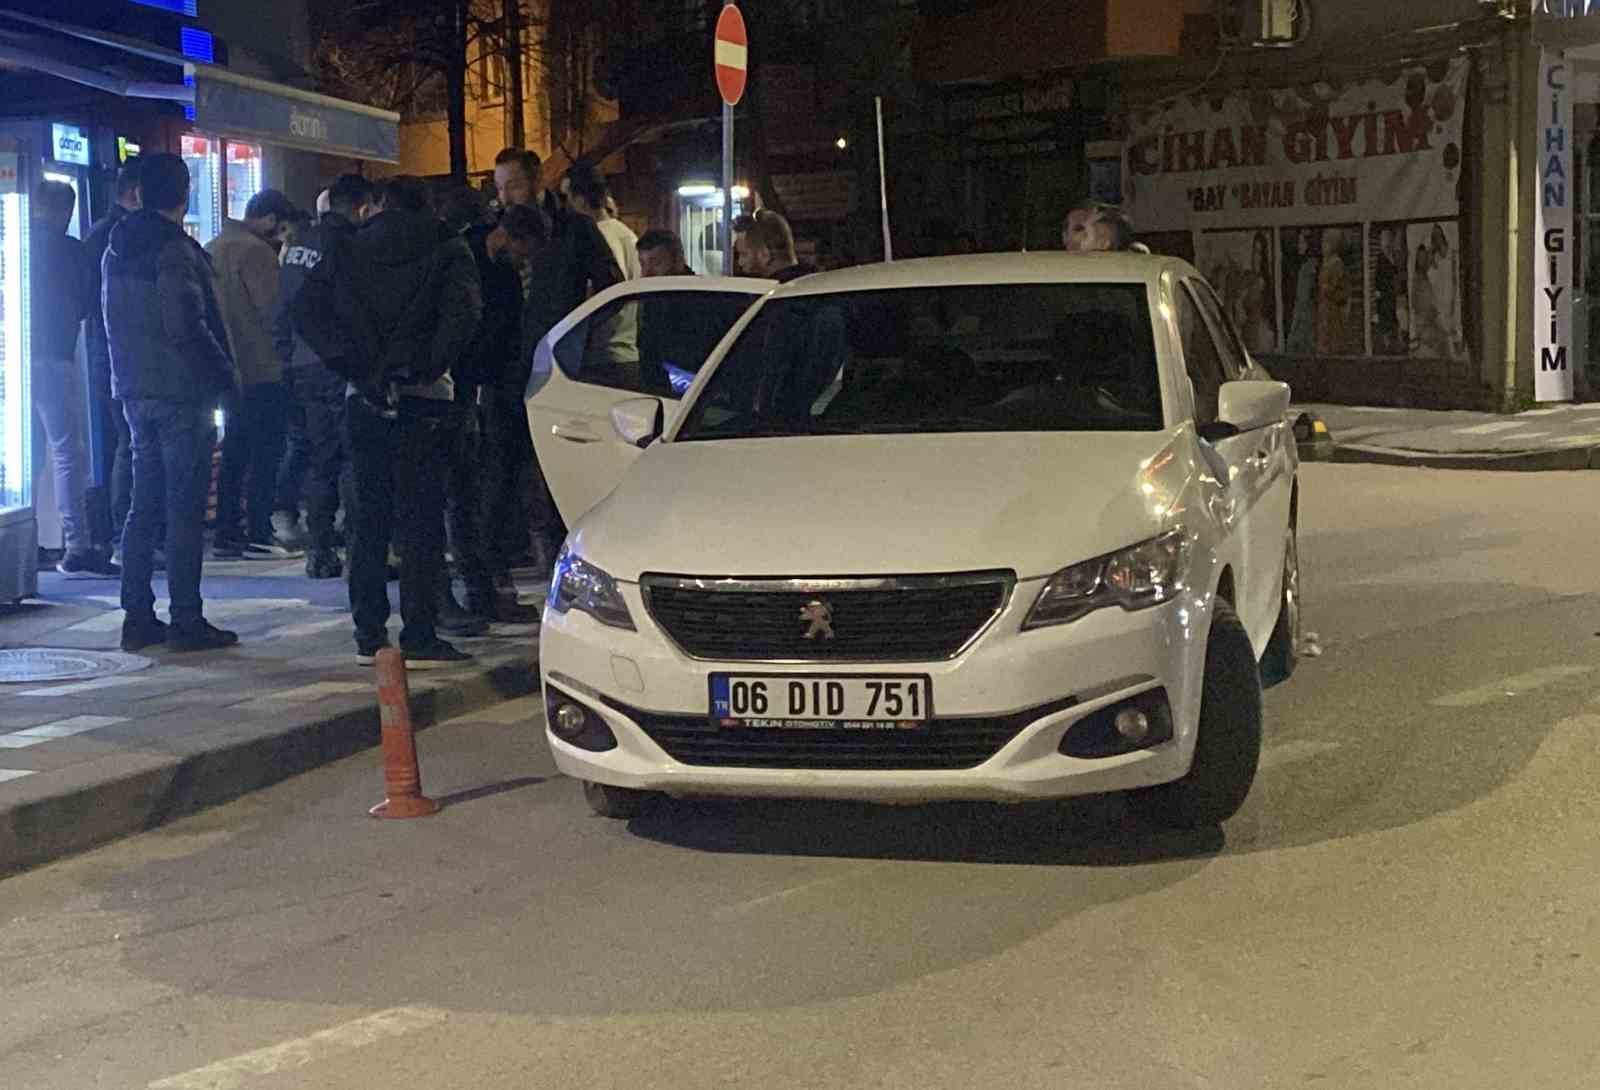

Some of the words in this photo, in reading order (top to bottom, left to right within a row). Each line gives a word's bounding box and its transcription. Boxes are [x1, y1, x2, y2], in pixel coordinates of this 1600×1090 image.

[1544, 65, 1566, 209] CİHAN
[1540, 228, 1568, 371] GİYİM
[731, 680, 769, 715] 06
[788, 681, 845, 716] DID
[865, 682, 920, 717] 751
